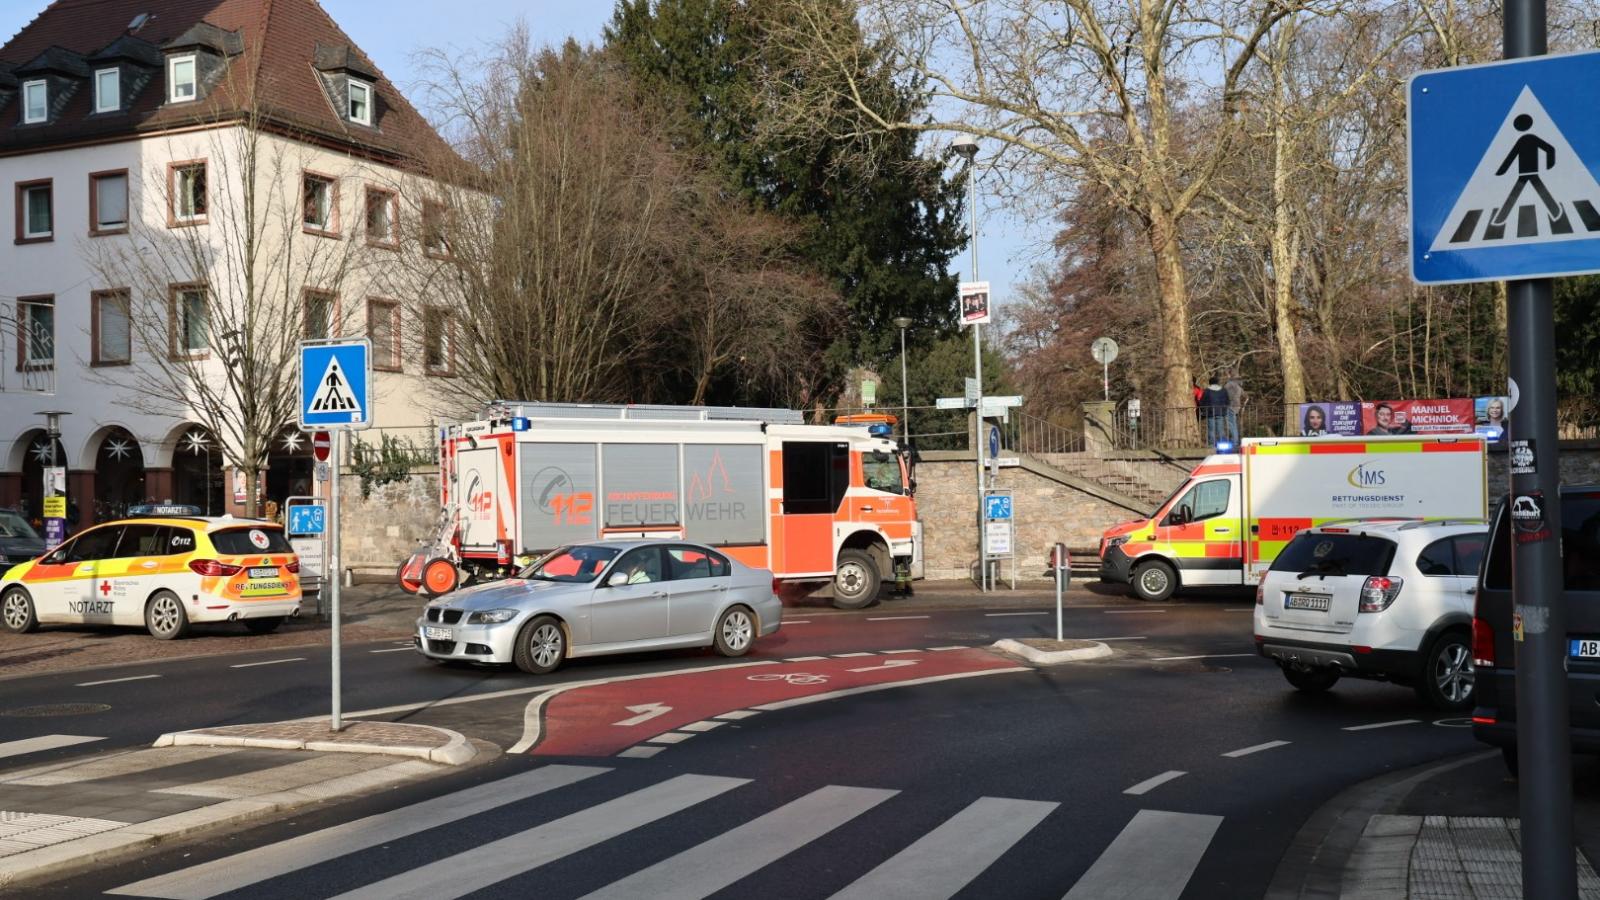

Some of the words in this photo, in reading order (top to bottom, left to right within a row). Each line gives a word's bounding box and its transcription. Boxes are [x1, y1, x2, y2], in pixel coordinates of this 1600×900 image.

[1411, 405, 1451, 414] MANUEL
[1411, 415, 1459, 424] MICHNIOK
[549, 492, 593, 515] 112
[156, 506, 183, 514] NOTARZT
[180, 537, 192, 546] 112
[68, 600, 115, 614] NOTARZT
[1580, 641, 1598, 656] AB
